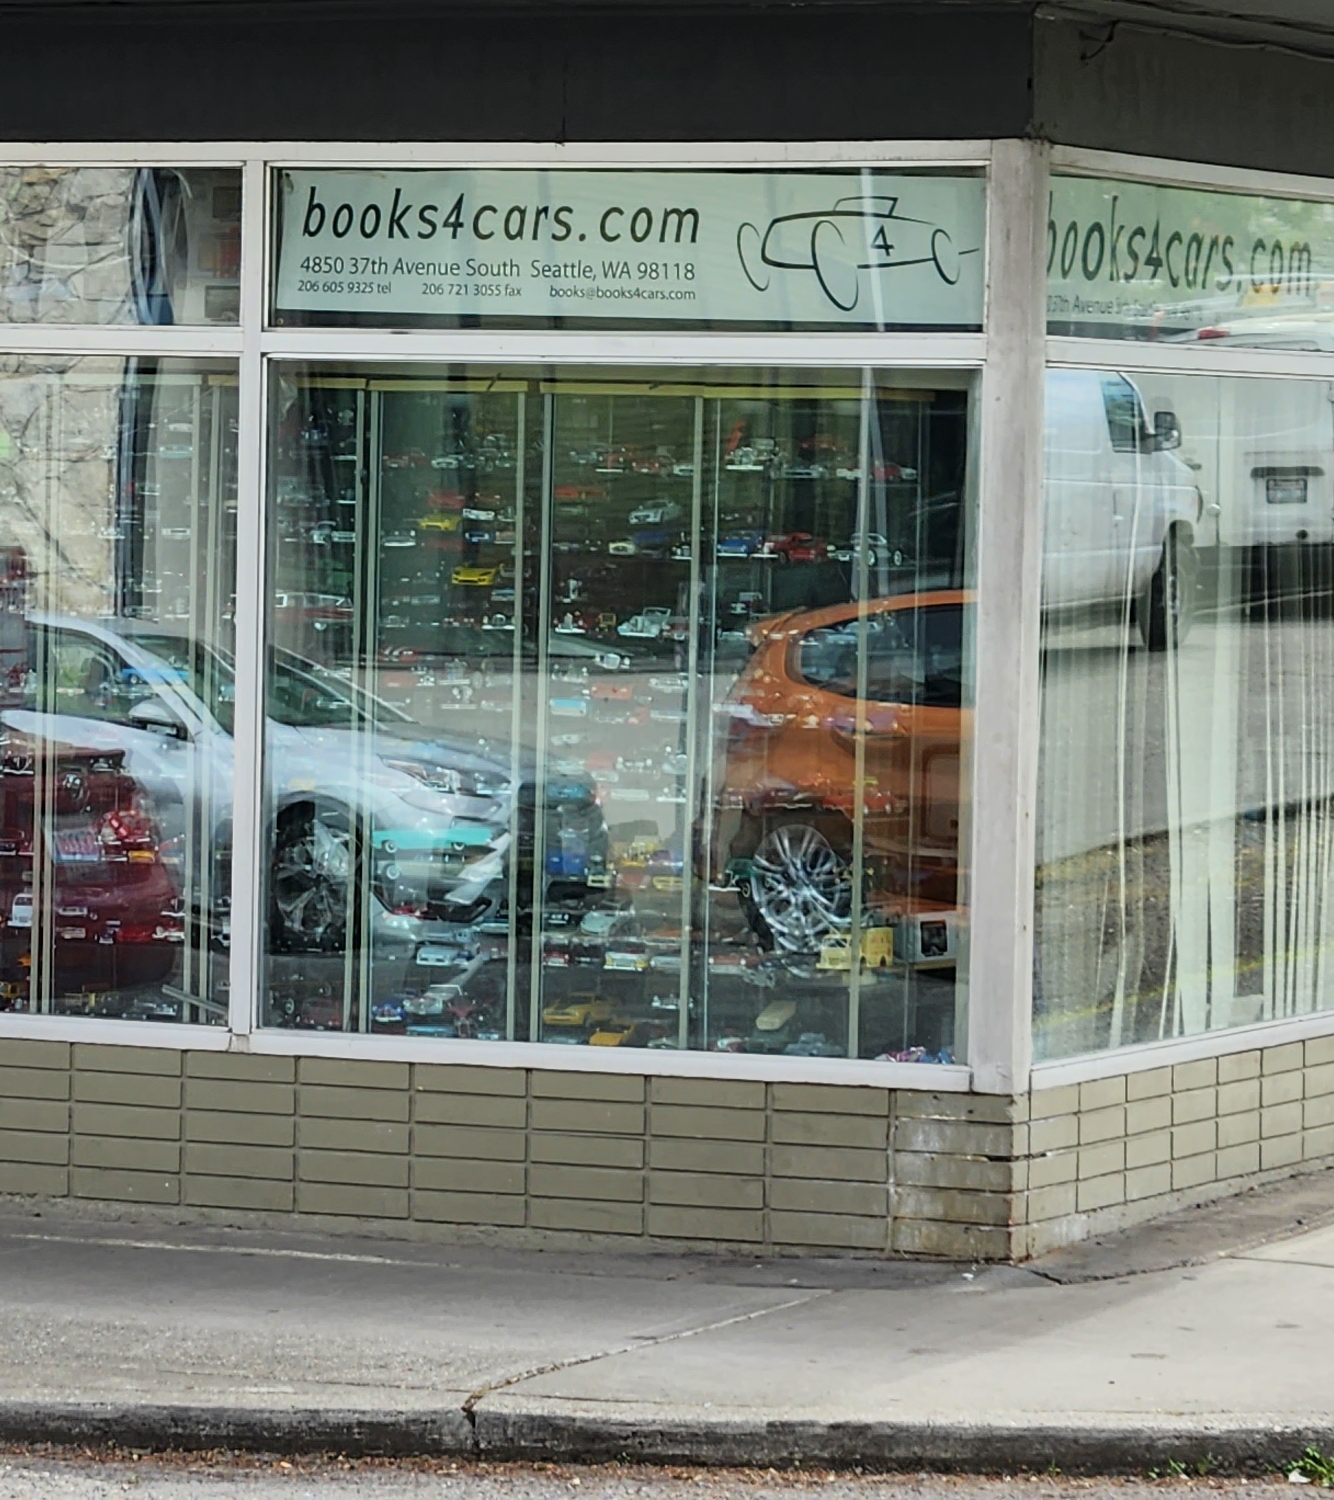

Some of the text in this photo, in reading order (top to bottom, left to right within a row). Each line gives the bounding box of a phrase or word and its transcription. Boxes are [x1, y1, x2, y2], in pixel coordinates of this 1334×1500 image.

[302, 186, 700, 243] books4cars.com
[300, 256, 696, 282] 4850 37th Avenue South Seattle, WA 98118
[297, 280, 392, 294] 206 605 9325 tel
[421, 282, 522, 297] 206 721 3055 fax
[549, 284, 696, 301] books@books4cars.com
